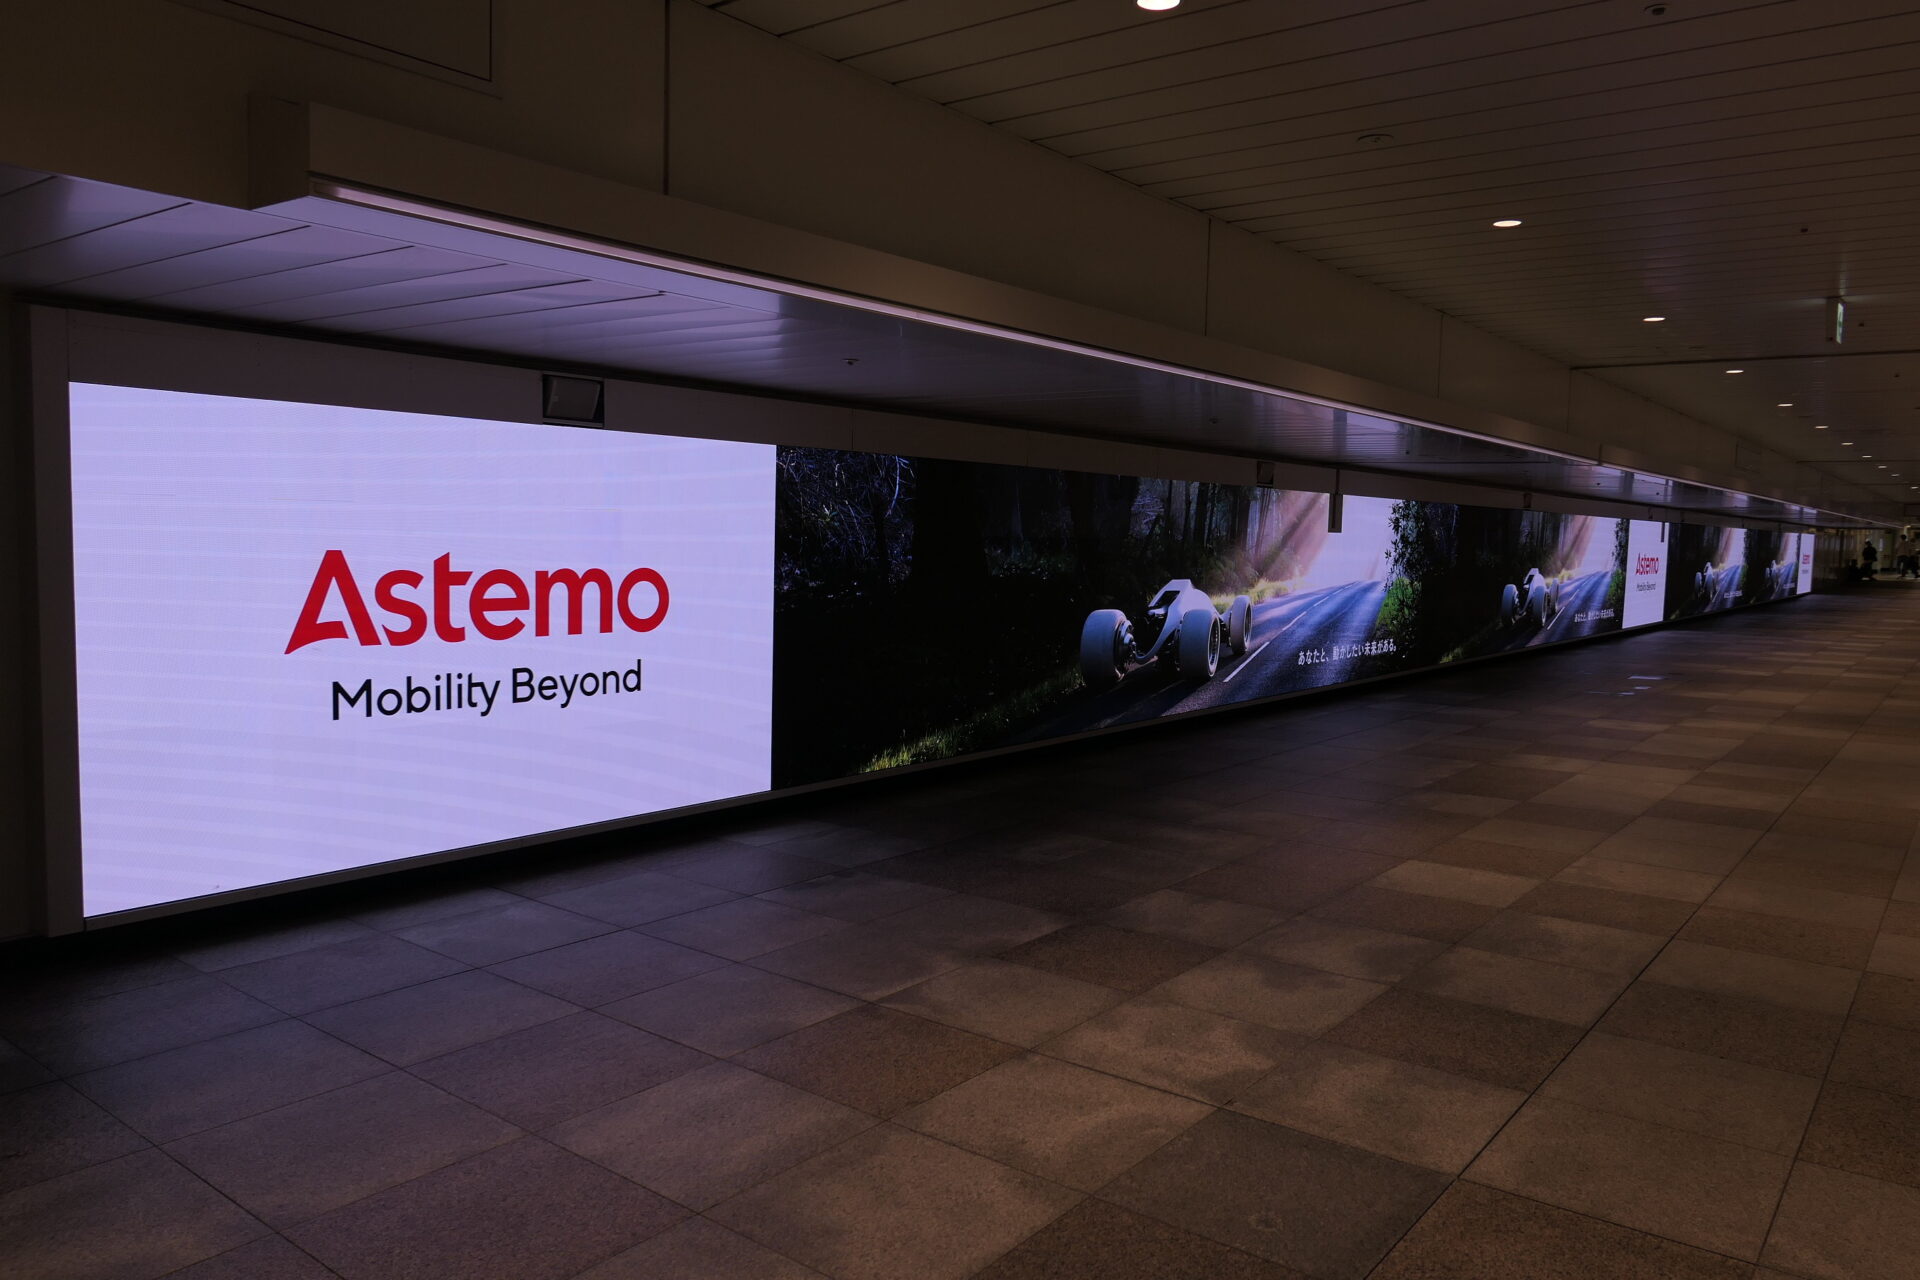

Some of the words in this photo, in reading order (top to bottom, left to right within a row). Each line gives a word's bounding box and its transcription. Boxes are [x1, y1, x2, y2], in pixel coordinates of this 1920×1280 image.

[1636, 553, 1660, 575] Astemo
[285, 550, 670, 655] Astemo
[1298, 639, 1397, 665] あなたと、動かしたい未来がある。
[332, 672, 500, 720] Mobility
[511, 659, 642, 708] Beyond
